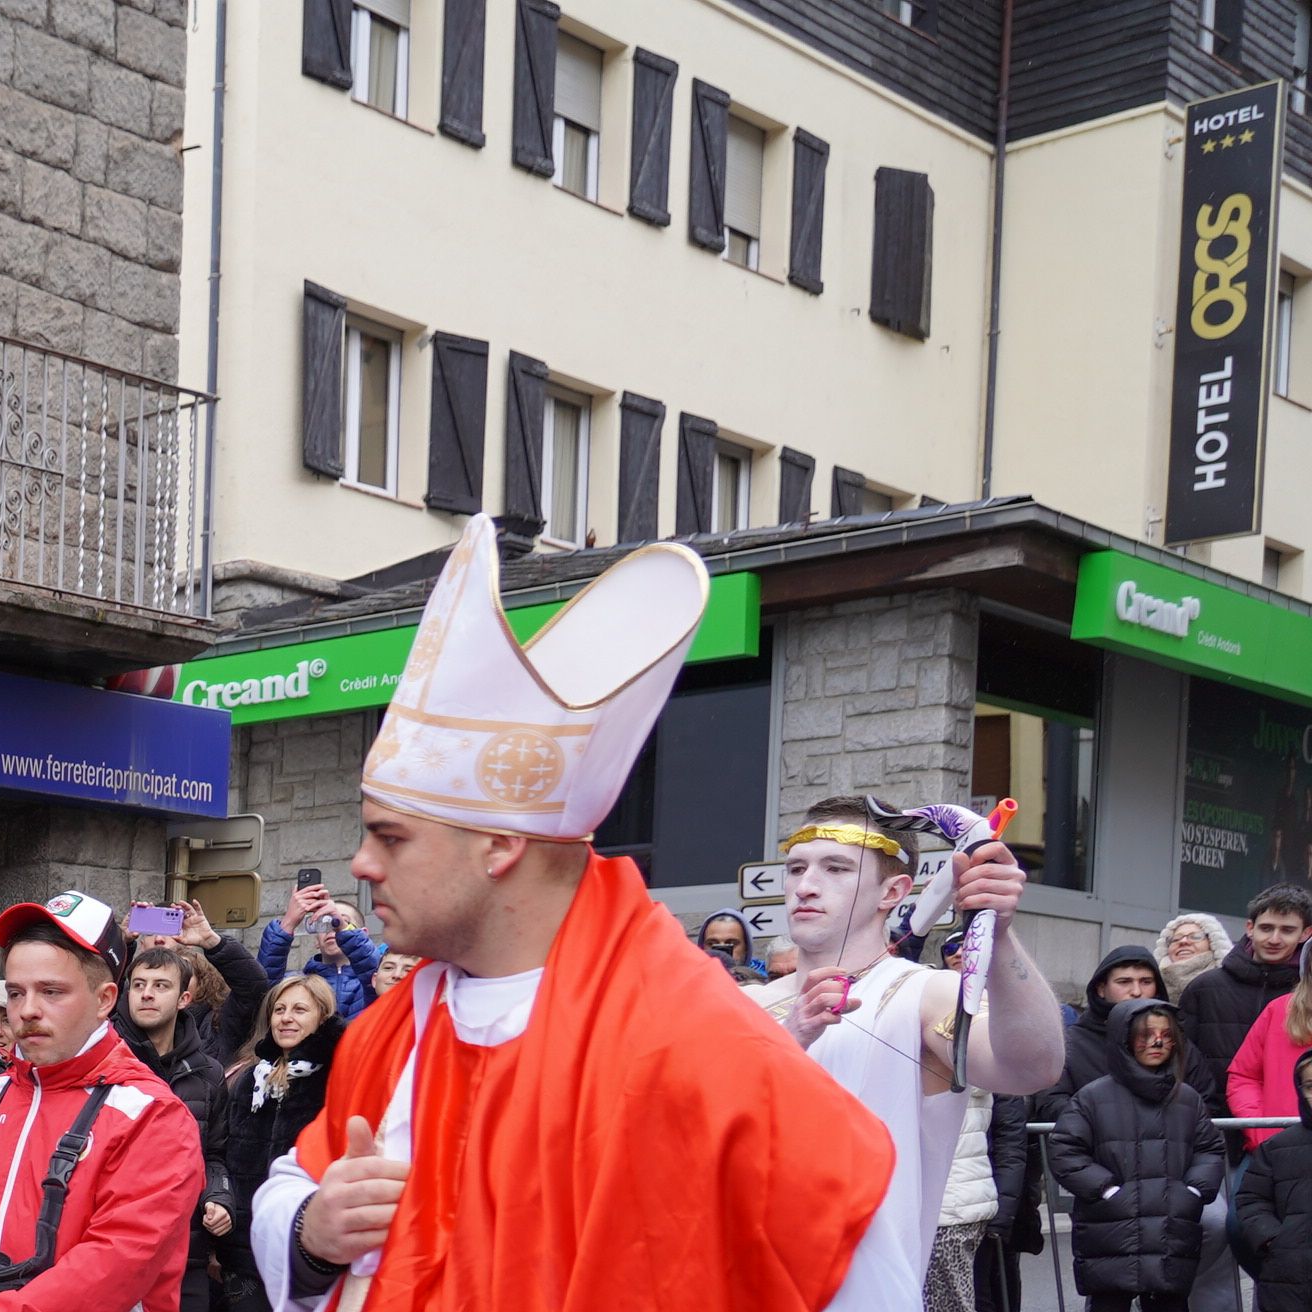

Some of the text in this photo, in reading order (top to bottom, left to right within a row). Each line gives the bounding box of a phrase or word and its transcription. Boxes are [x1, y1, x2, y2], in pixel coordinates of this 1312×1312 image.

[1193, 104, 1265, 135] HOTEL
[1191, 193, 1253, 491] HOTEL OROS
[340, 676, 378, 693] Crèdit
[1, 753, 213, 802] www.ferreteriaprincipat.com
[1192, 844, 1225, 869] CREEN
